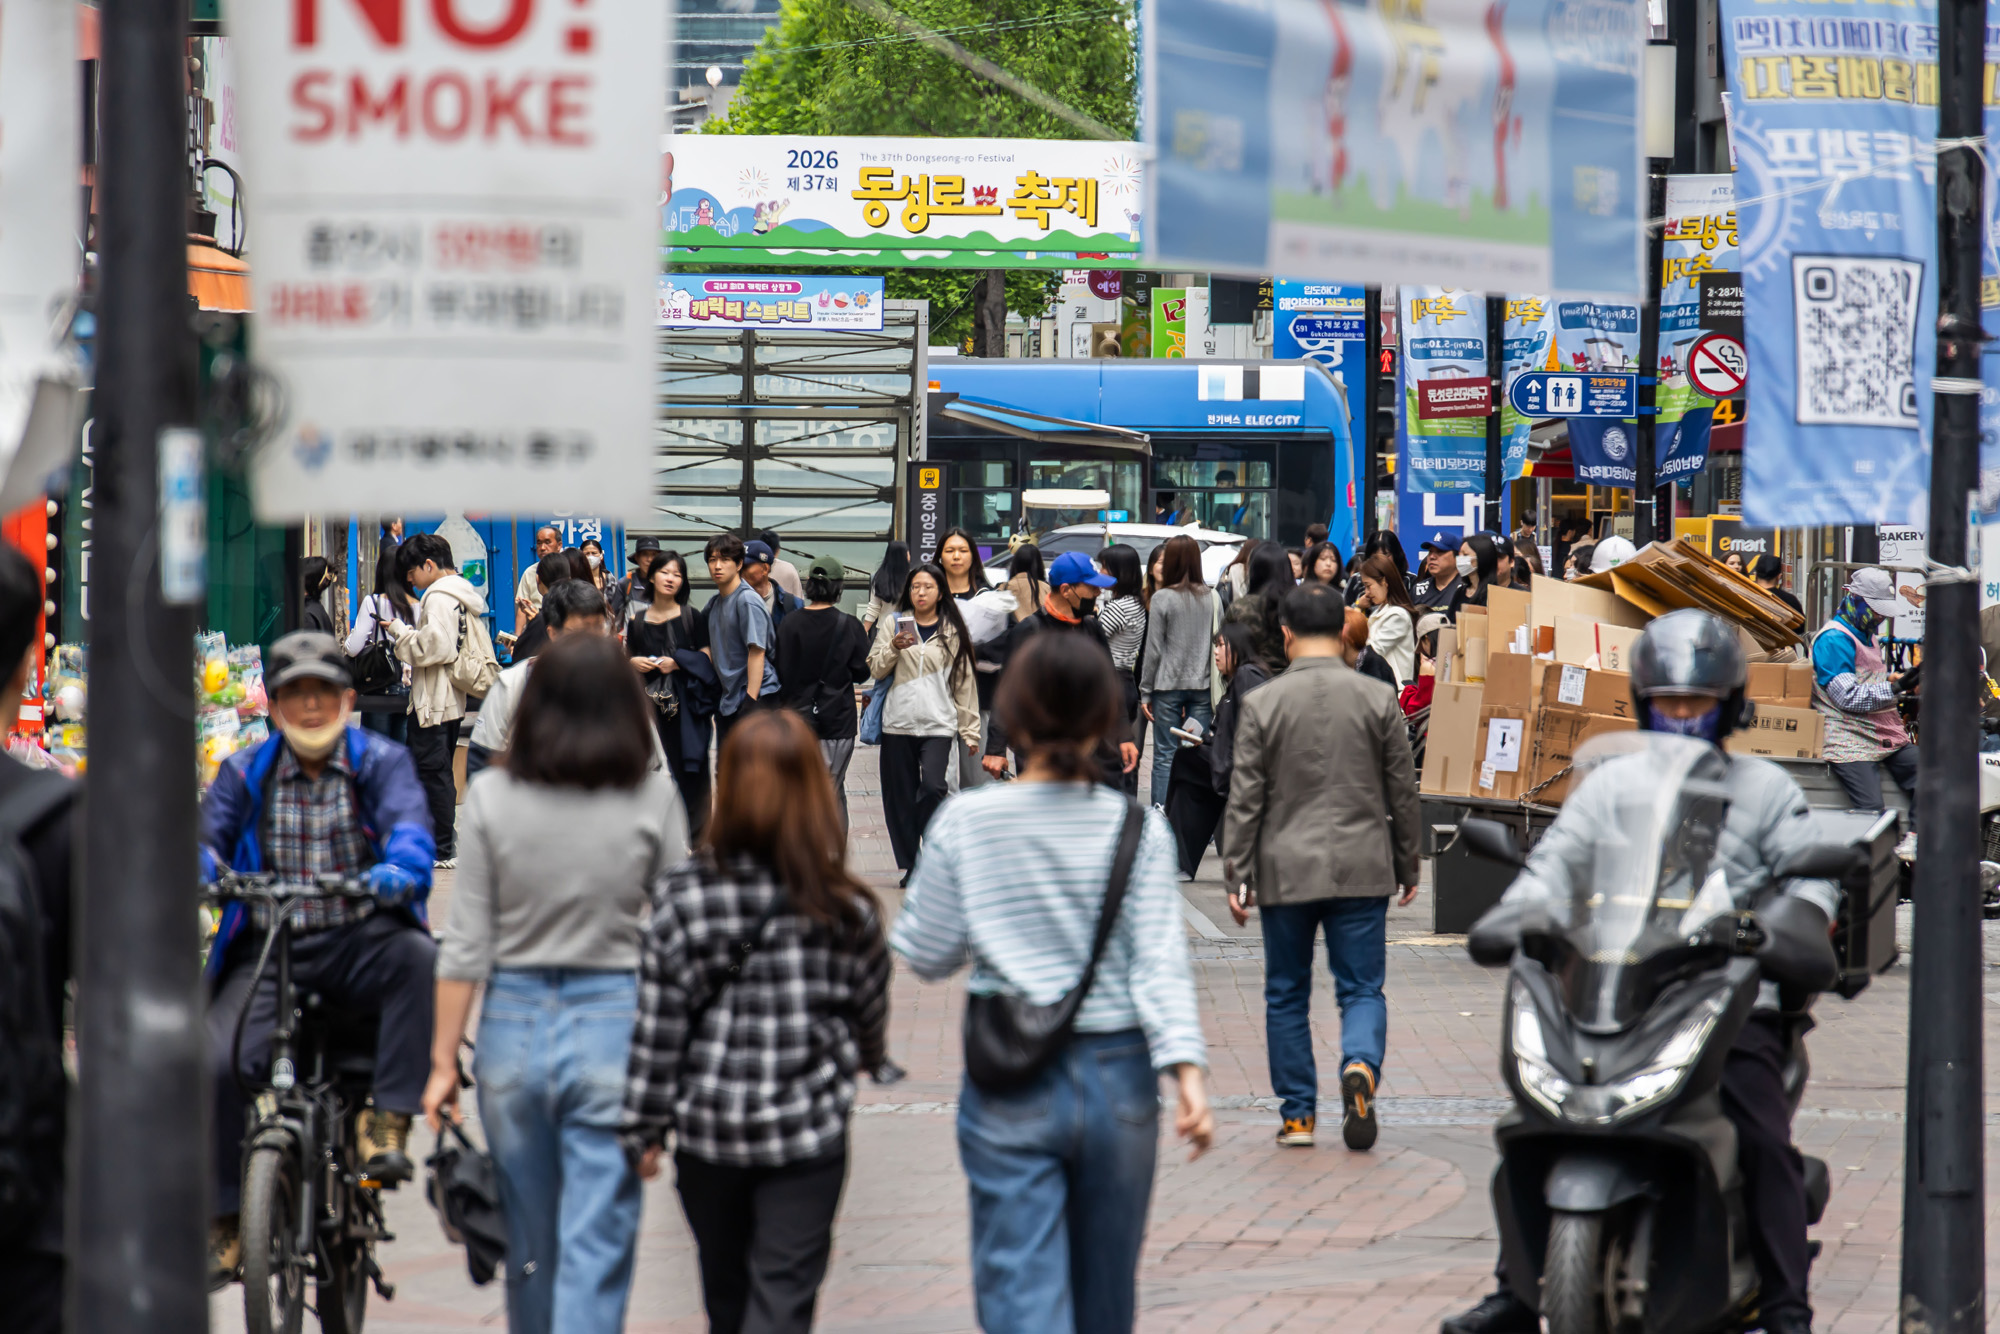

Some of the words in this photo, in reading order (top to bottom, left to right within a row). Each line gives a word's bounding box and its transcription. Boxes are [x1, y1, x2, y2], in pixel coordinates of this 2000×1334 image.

[290, 70, 592, 147] SMOKE
[787, 150, 839, 169] 2026
[860, 153, 878, 162] The
[881, 153, 903, 162] 37th
[906, 153, 975, 164] Dongseong-ro
[978, 153, 1015, 163] Festival
[787, 174, 838, 193] 제37회
[851, 166, 1003, 234] 동성로
[1006, 169, 1099, 231] 축제
[713, 282, 729, 292] 국내
[729, 282, 745, 292] 최대
[746, 282, 769, 293] 캐릭터
[770, 283, 793, 293] 상점가
[1097, 280, 1121, 293] 예인
[690, 296, 744, 321] 캐릭터
[745, 301, 811, 323] 스트리트
[1314, 320, 1360, 331] 국제보상로
[1207, 414, 1241, 425] 전기버스
[1245, 415, 1273, 425] ELEC
[1274, 415, 1301, 425] CITY
[550, 518, 603, 545] 가정
[1880, 531, 1926, 541] BAKERY
[1719, 536, 1767, 553] emart
